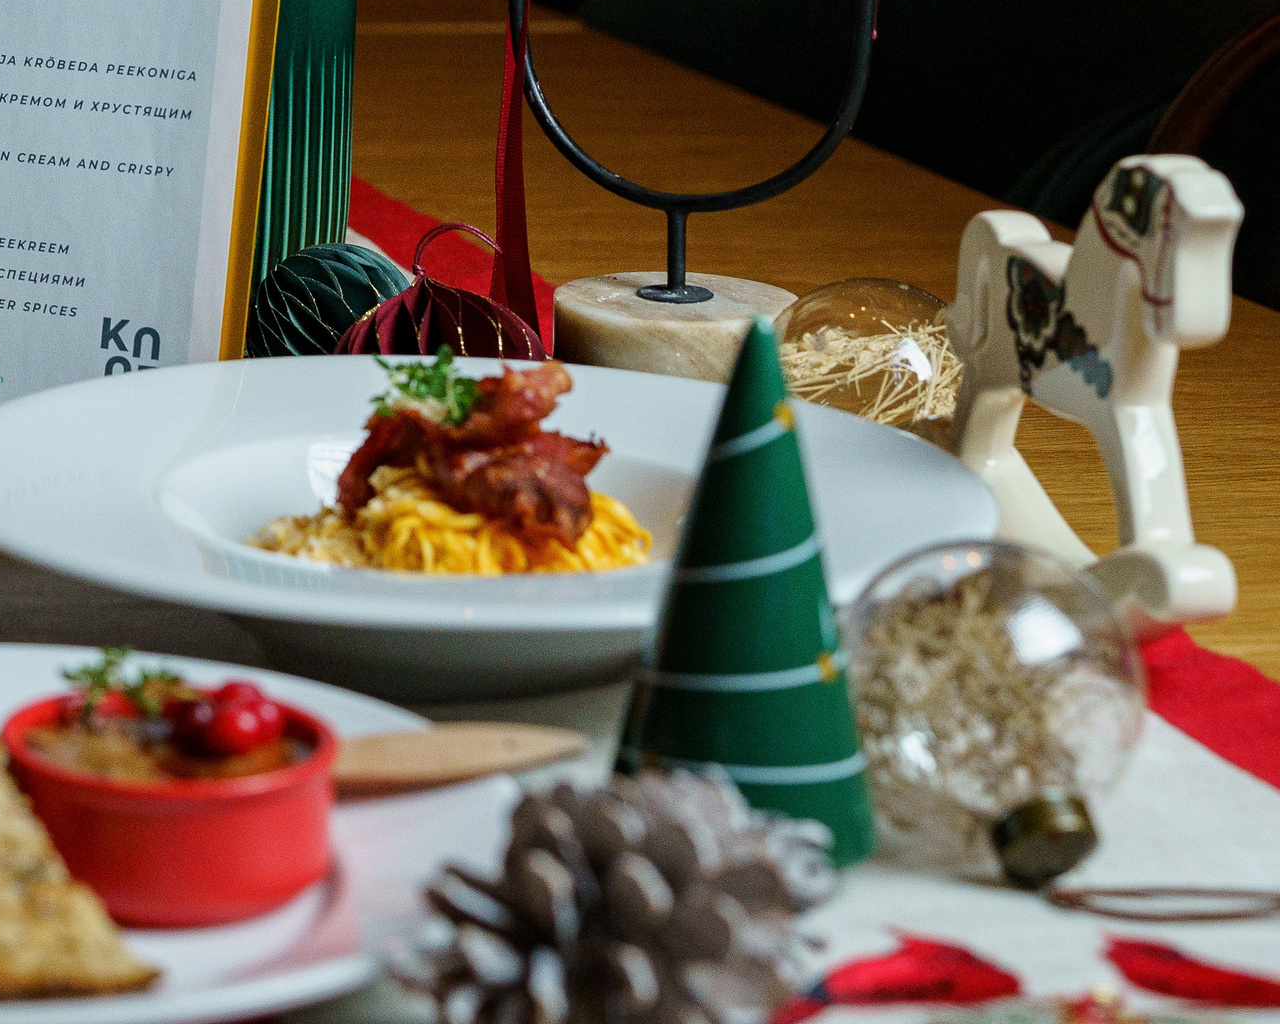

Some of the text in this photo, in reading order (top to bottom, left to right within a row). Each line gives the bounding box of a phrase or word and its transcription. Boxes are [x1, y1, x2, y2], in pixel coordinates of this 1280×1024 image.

[23, 56, 99, 73] KRÕBEDA
[105, 63, 197, 82] PEEKONIGA
[73, 99, 85, 111] И
[90, 100, 193, 121] ХРУСТЯЩИМ
[16, 152, 71, 168] CREAM
[76, 158, 111, 172] AND
[116, 161, 175, 178] CRISPY
[22, 301, 78, 318] SPICES
